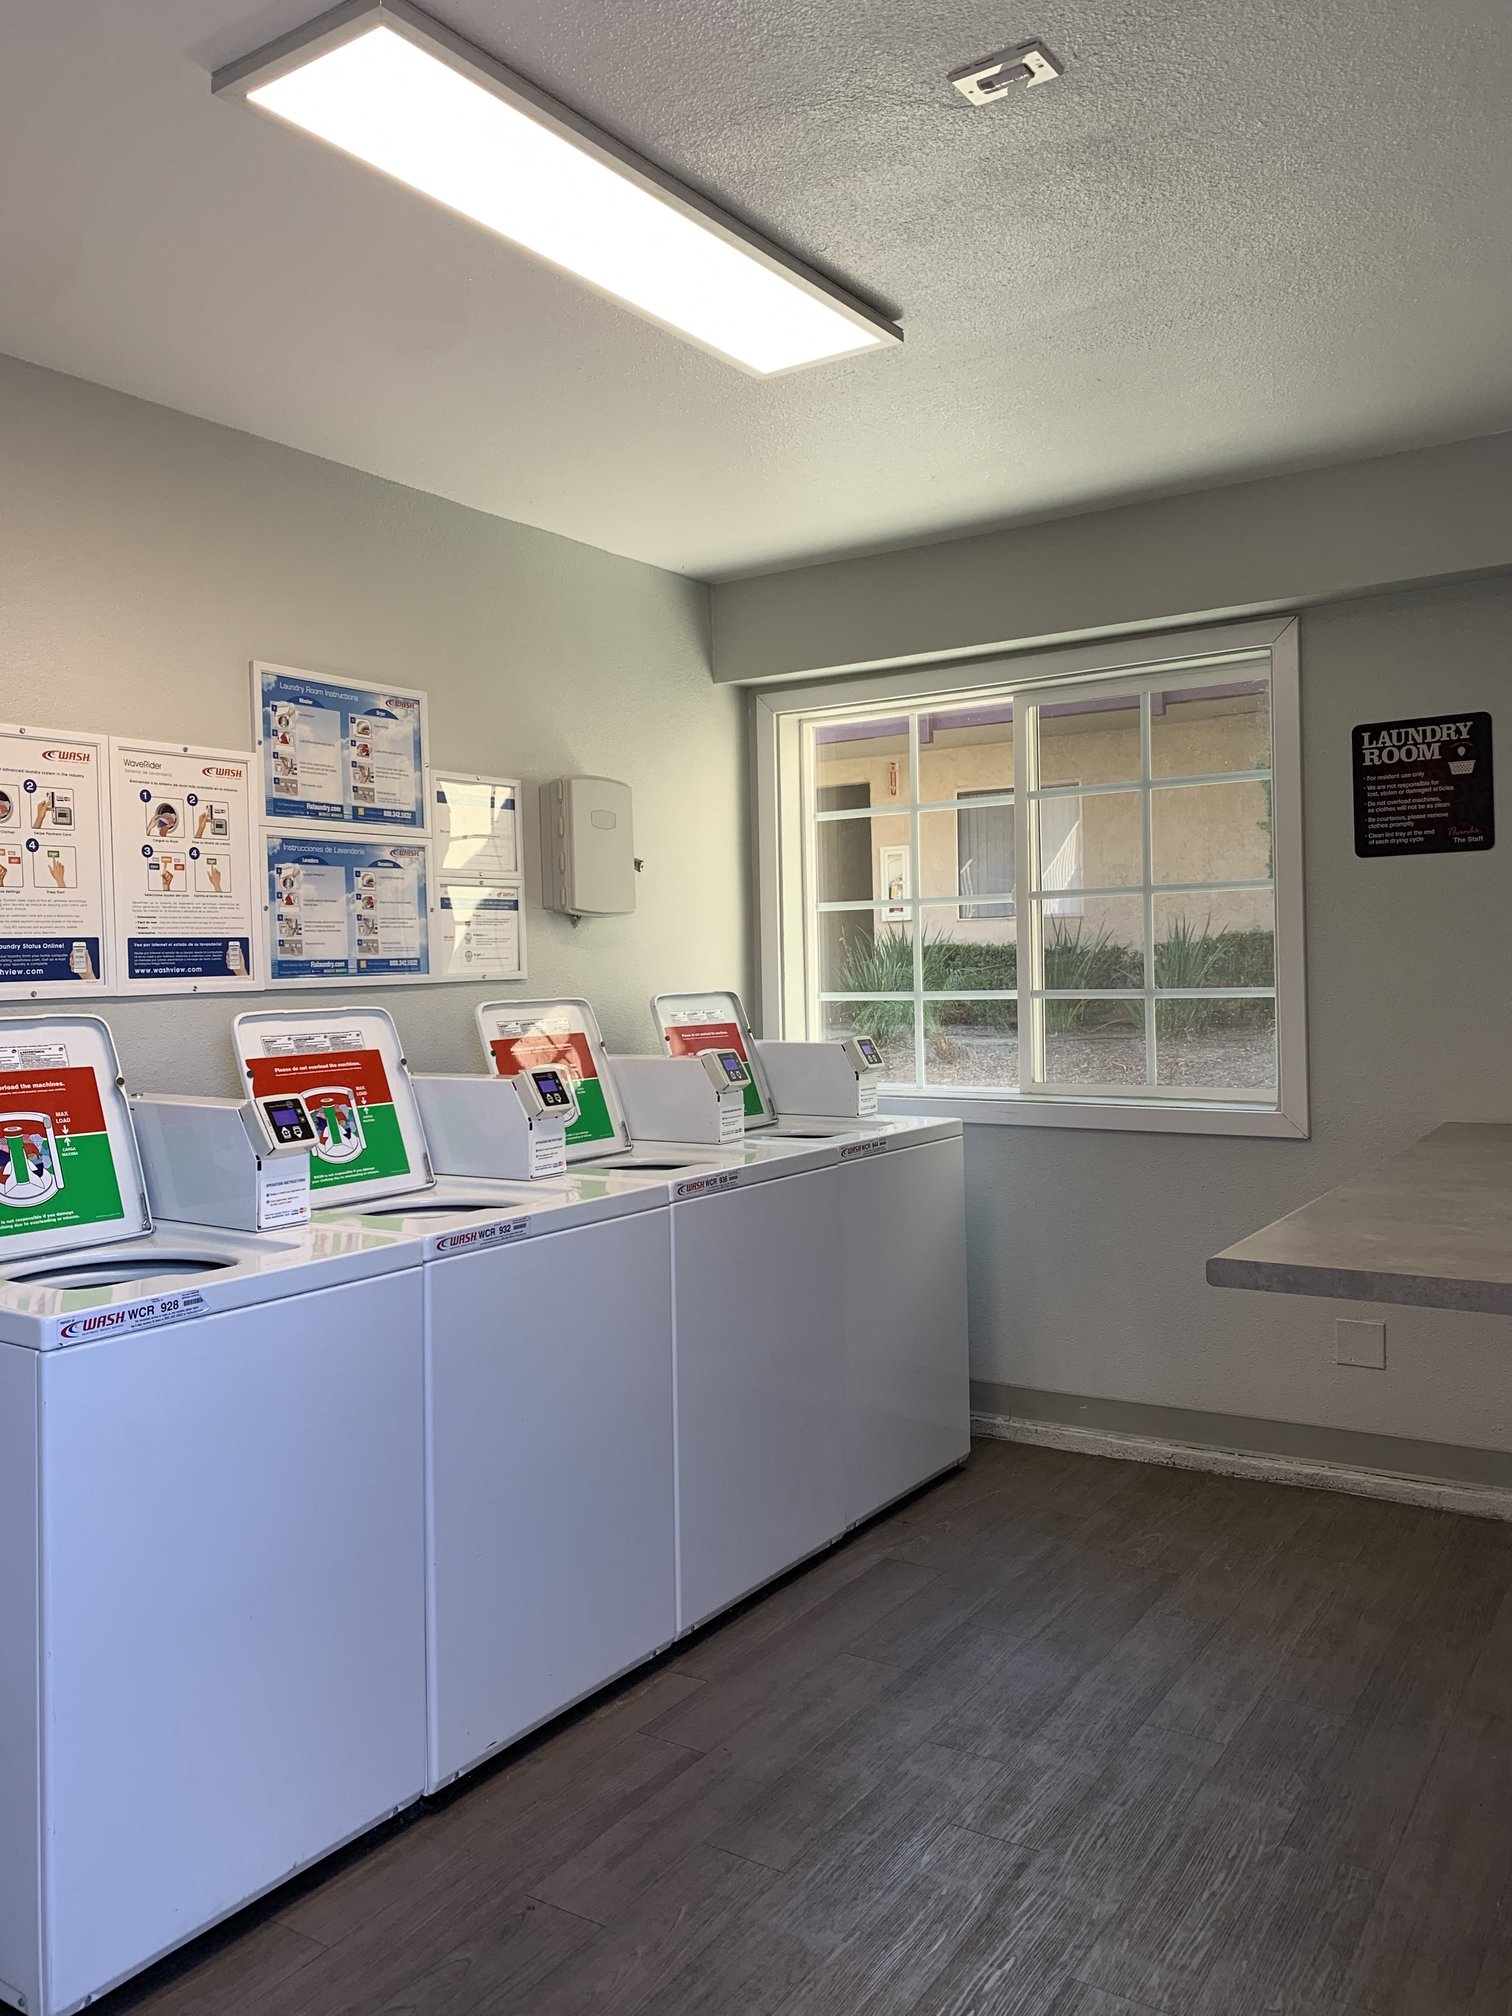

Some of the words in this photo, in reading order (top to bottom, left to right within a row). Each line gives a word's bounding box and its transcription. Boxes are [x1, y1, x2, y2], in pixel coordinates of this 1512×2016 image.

[280, 682, 304, 694] Laundry
[306, 686, 323, 695] Room
[325, 690, 358, 701] Instructions
[395, 700, 414, 709] WASH
[1362, 722, 1473, 748] LAUNDRY
[58, 751, 90, 761] WASH
[1362, 743, 1441, 766] ROOM
[123, 759, 161, 769] WaveRider
[216, 768, 242, 777] WASH
[27, 782, 33, 790] 2
[144, 847, 150, 855] 3
[283, 844, 323, 852] Instrucciones
[325, 845, 332, 853] de
[687, 1181, 704, 1191] WASH
[705, 1178, 717, 1186] WCR
[451, 1232, 477, 1246] WASH
[479, 1228, 495, 1238] WCR
[499, 1225, 511, 1234] 932
[83, 1311, 124, 1331] WASH
[128, 1306, 155, 1320] WCR
[161, 1300, 179, 1312] 928
